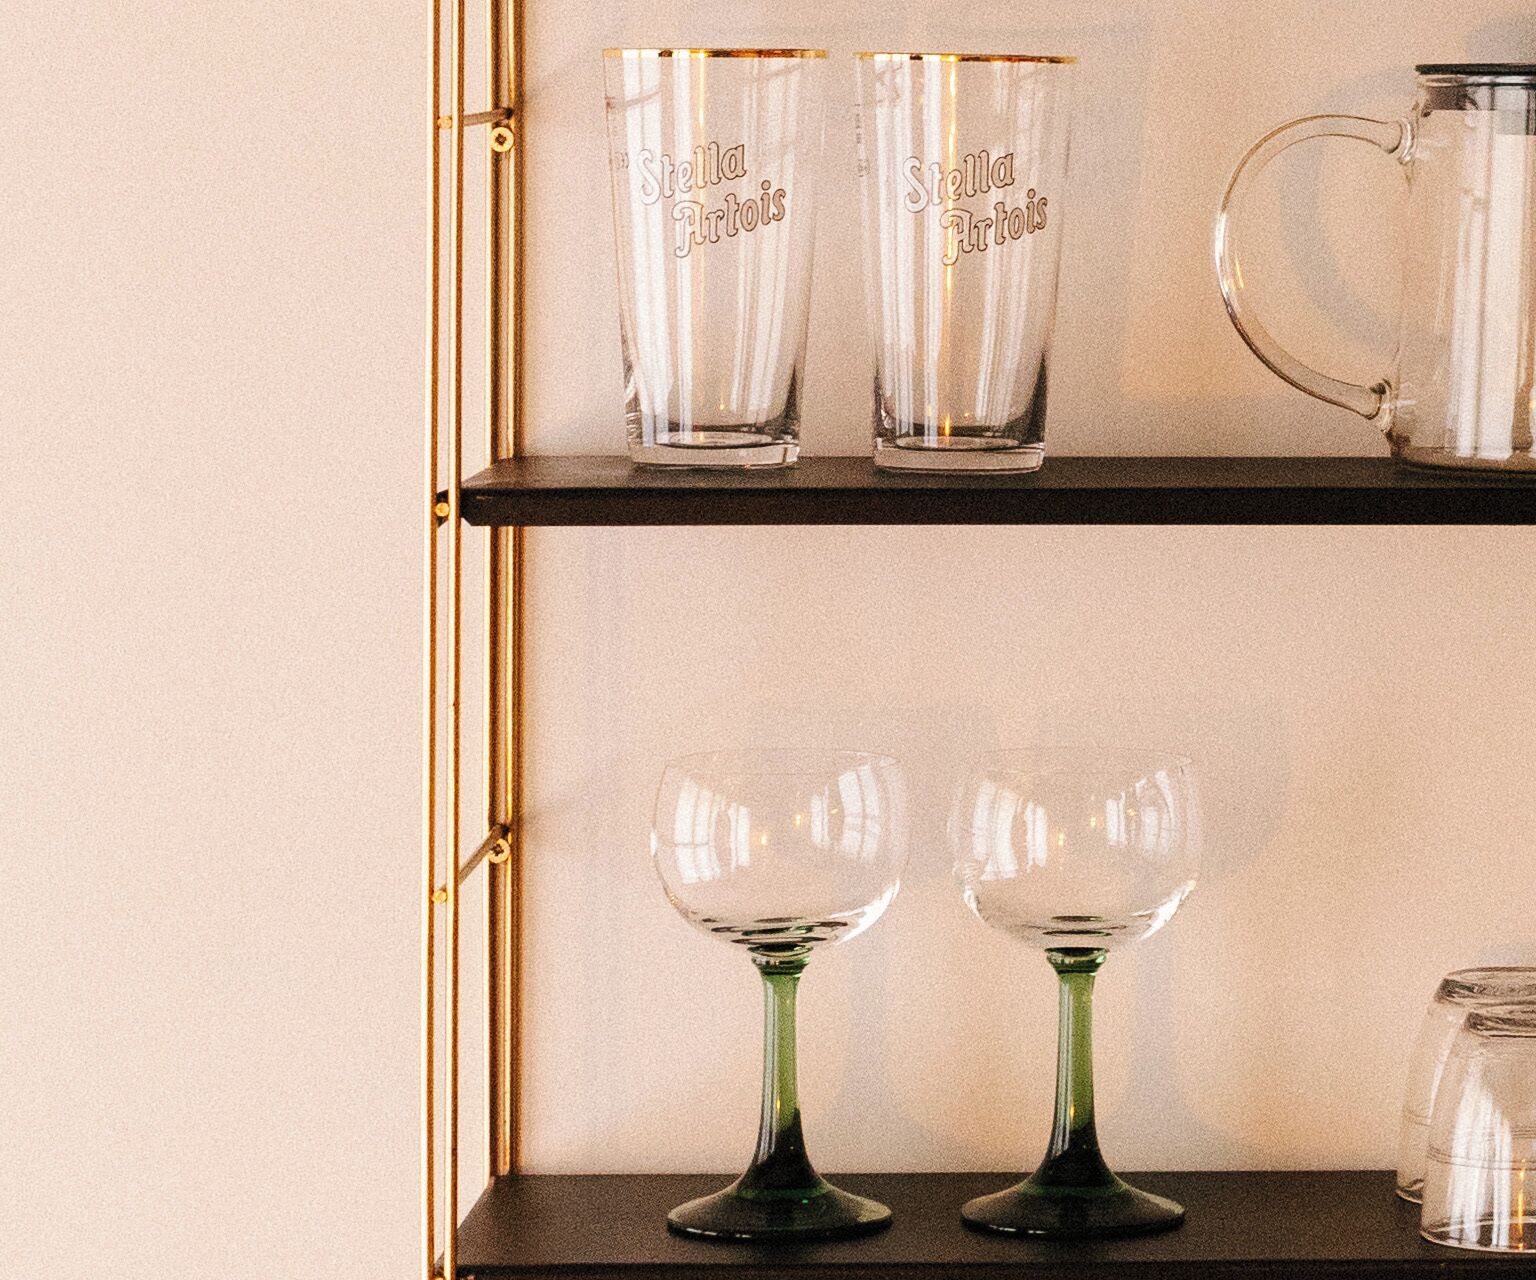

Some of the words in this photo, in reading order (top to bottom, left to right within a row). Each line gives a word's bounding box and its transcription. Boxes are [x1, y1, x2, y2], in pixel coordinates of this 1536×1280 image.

[638, 141, 747, 206] Stella
[902, 150, 1015, 213] Stella
[671, 180, 786, 258] Artois
[939, 188, 1048, 266] Artois
